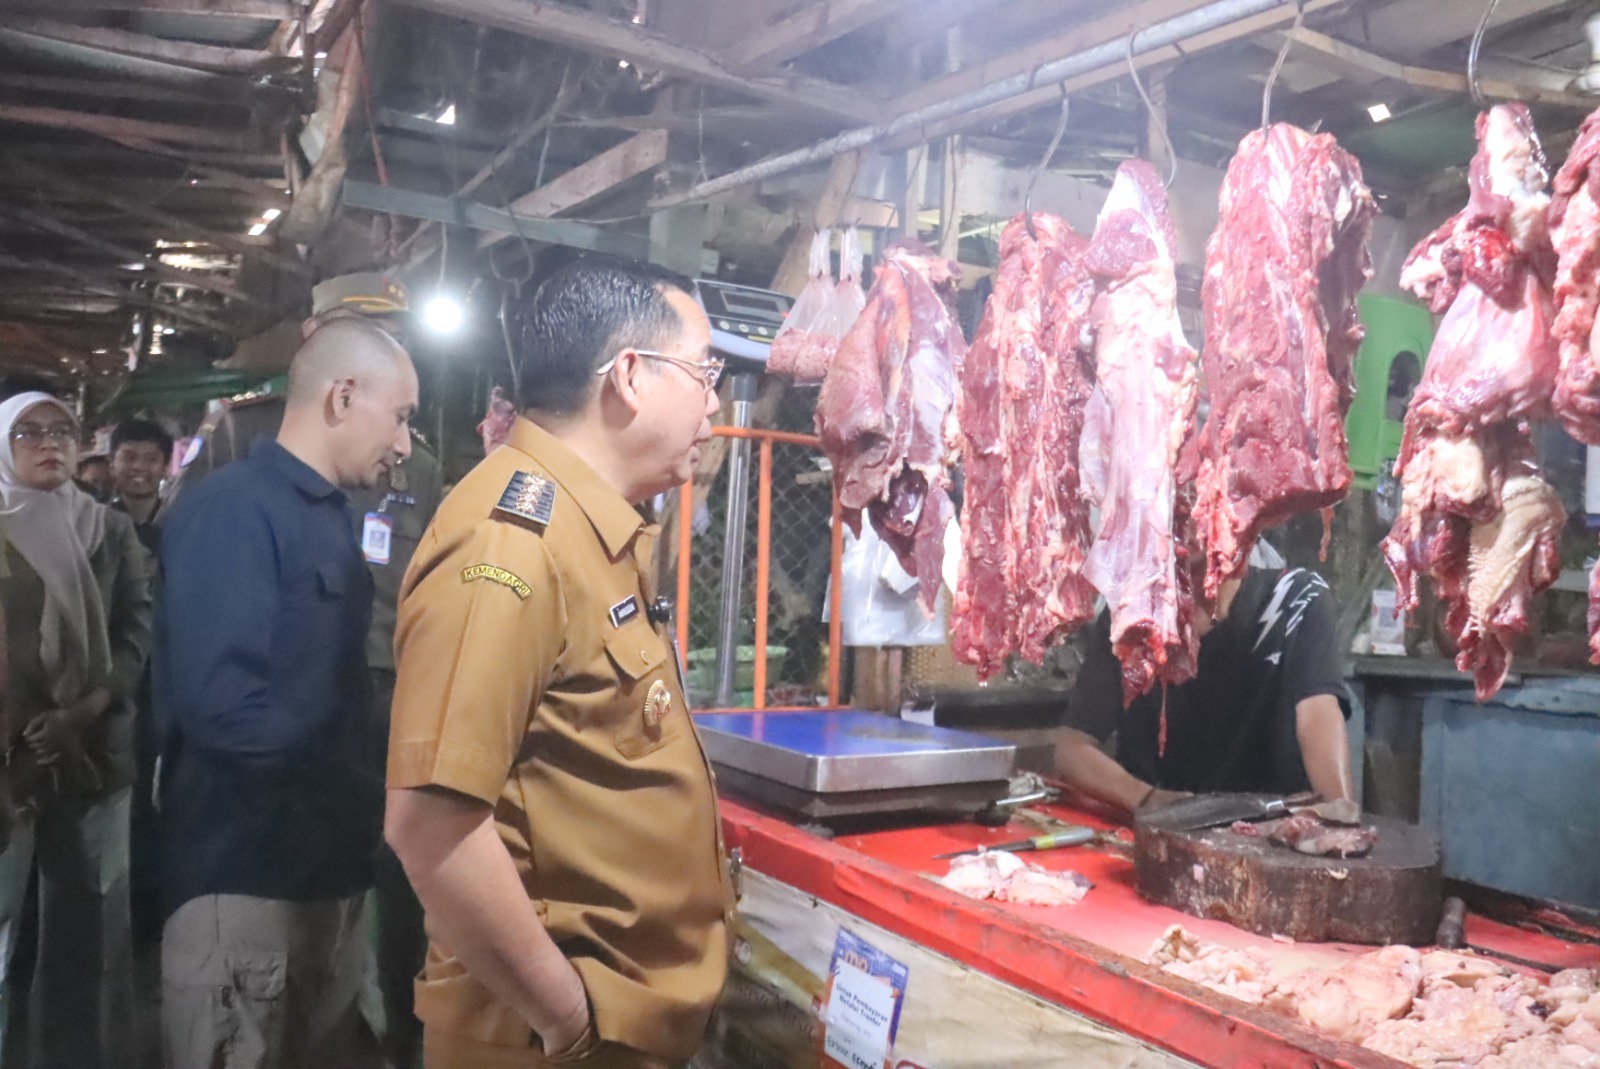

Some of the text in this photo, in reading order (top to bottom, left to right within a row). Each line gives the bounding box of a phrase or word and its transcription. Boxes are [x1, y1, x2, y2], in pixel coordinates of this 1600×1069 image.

[465, 566, 529, 596] KEMENDAGRI
[836, 983, 888, 1023] Untuk Pembayaran
[839, 994, 859, 1012] Melalui
